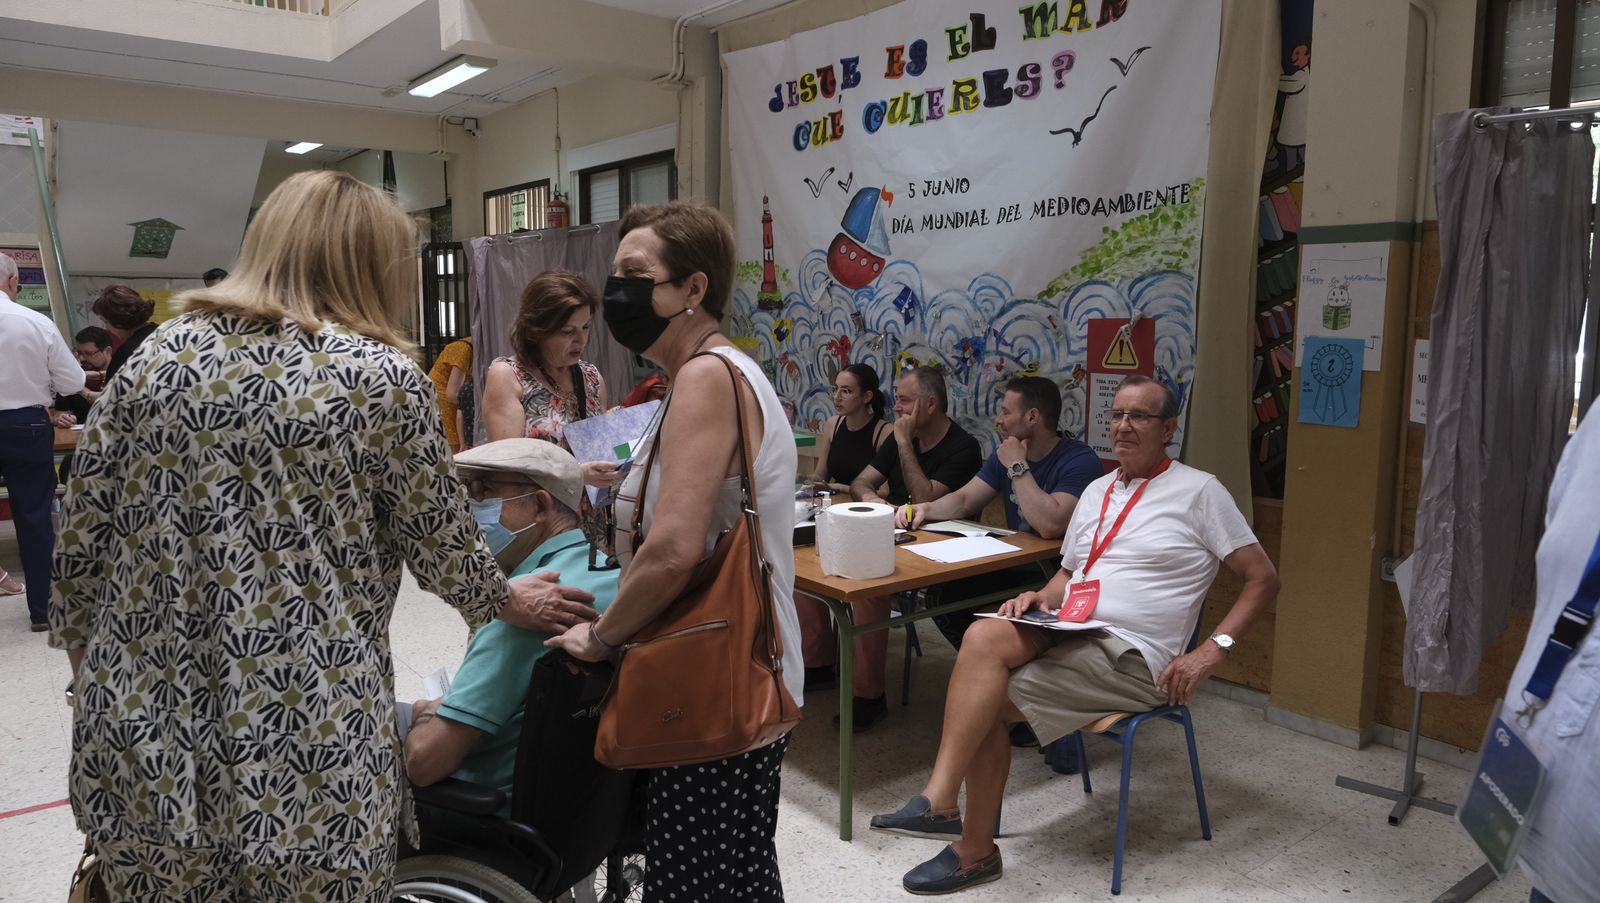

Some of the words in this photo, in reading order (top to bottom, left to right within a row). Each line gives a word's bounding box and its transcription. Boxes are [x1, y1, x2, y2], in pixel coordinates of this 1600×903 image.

[884, 39, 928, 80] ES
[944, 12, 997, 62] EL
[892, 215, 914, 235] DÍA
[920, 209, 990, 232] MUNDIAL
[996, 203, 1022, 225] DEL
[1030, 183, 1191, 220] MEDIOAMBIENTE
[908, 182, 916, 199] 5
[922, 177, 970, 198] JUNIO
